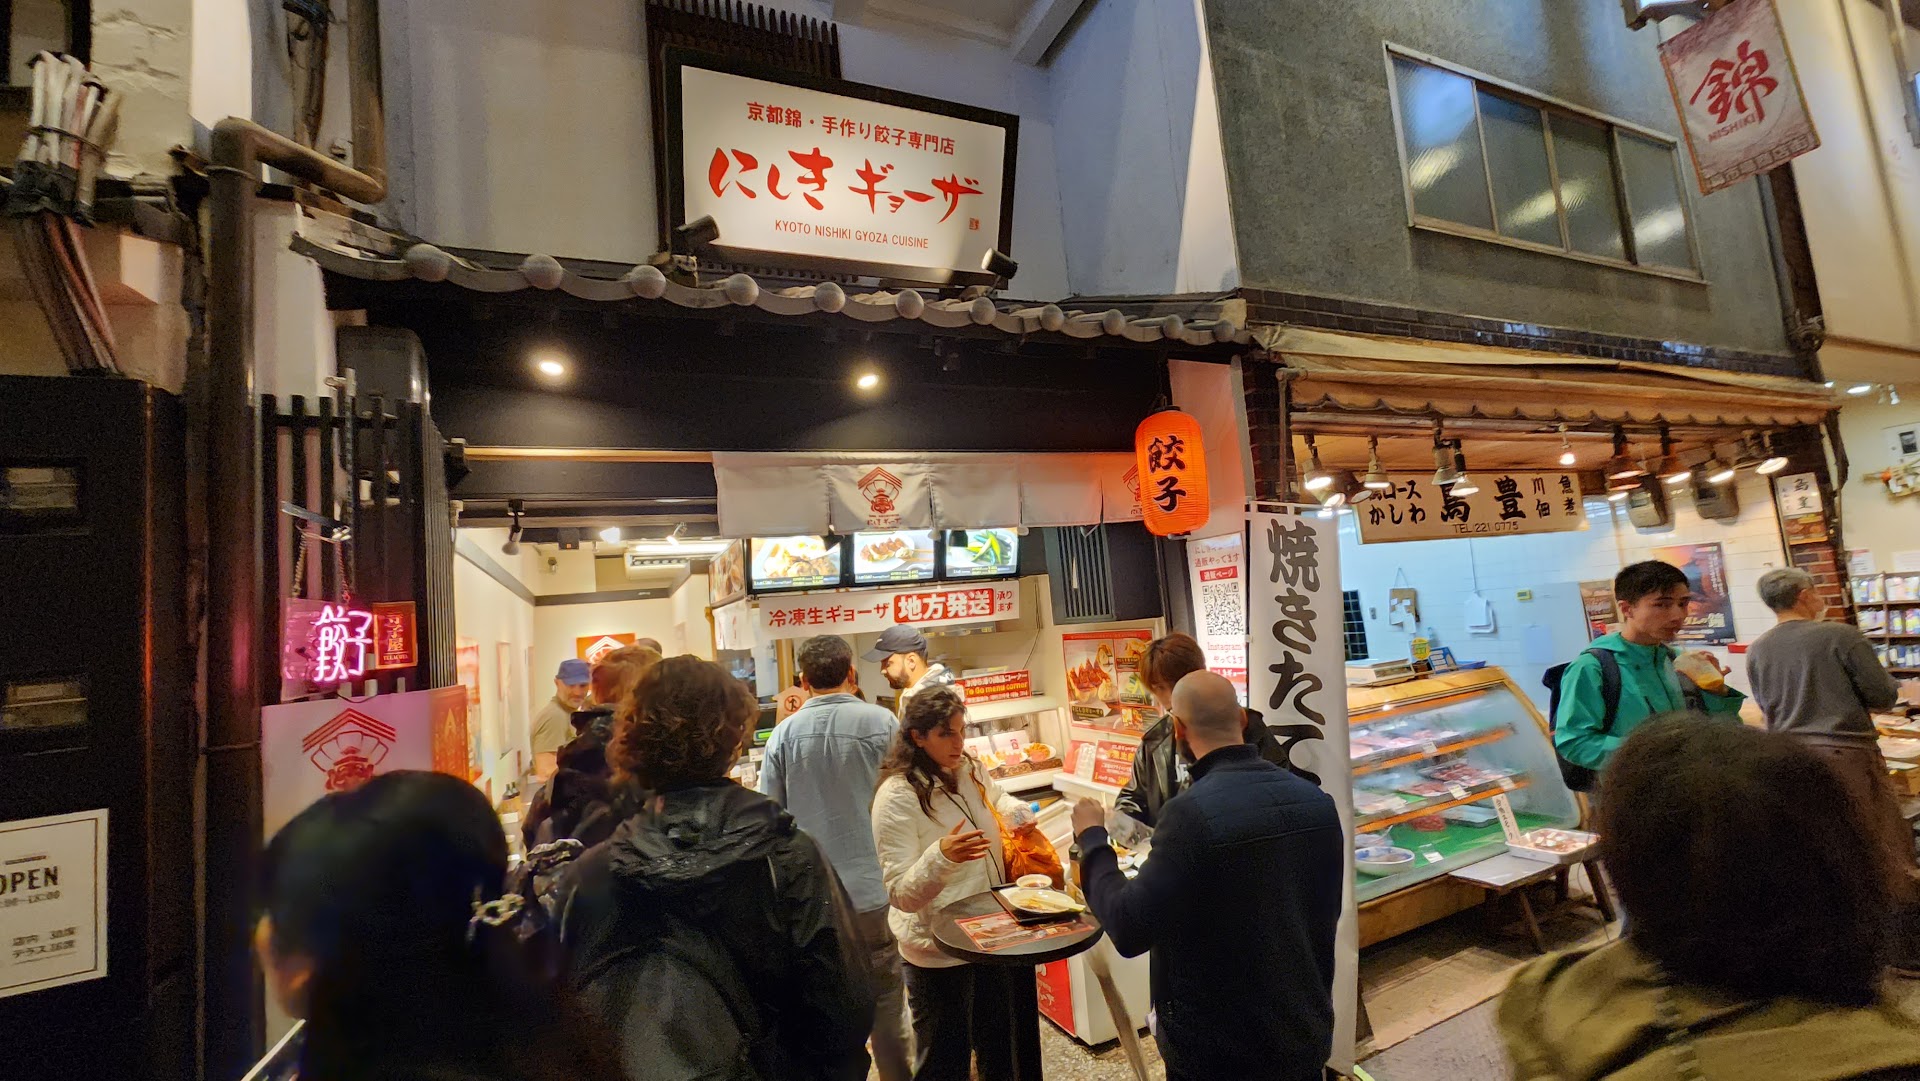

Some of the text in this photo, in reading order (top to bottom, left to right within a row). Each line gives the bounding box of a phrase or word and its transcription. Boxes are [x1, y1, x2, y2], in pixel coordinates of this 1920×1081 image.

[1689, 40, 1778, 124] 錦
[747, 101, 956, 156] 京都錦・手作り餃子専門店
[1708, 114, 1757, 142] NISHIKI
[708, 147, 984, 224] にしき ギョーザ
[775, 220, 929, 249] KYOTO NISHIKI GYOZA CUISINE
[1148, 435, 1187, 512] 餃子
[1369, 503, 1426, 525] かしわ
[769, 588, 991, 628] 冷凍生ギョーザ 地方発送
[996, 590, 1013, 600] 承り
[996, 603, 1013, 612] ます
[1267, 518, 1326, 787] 焼きたて
